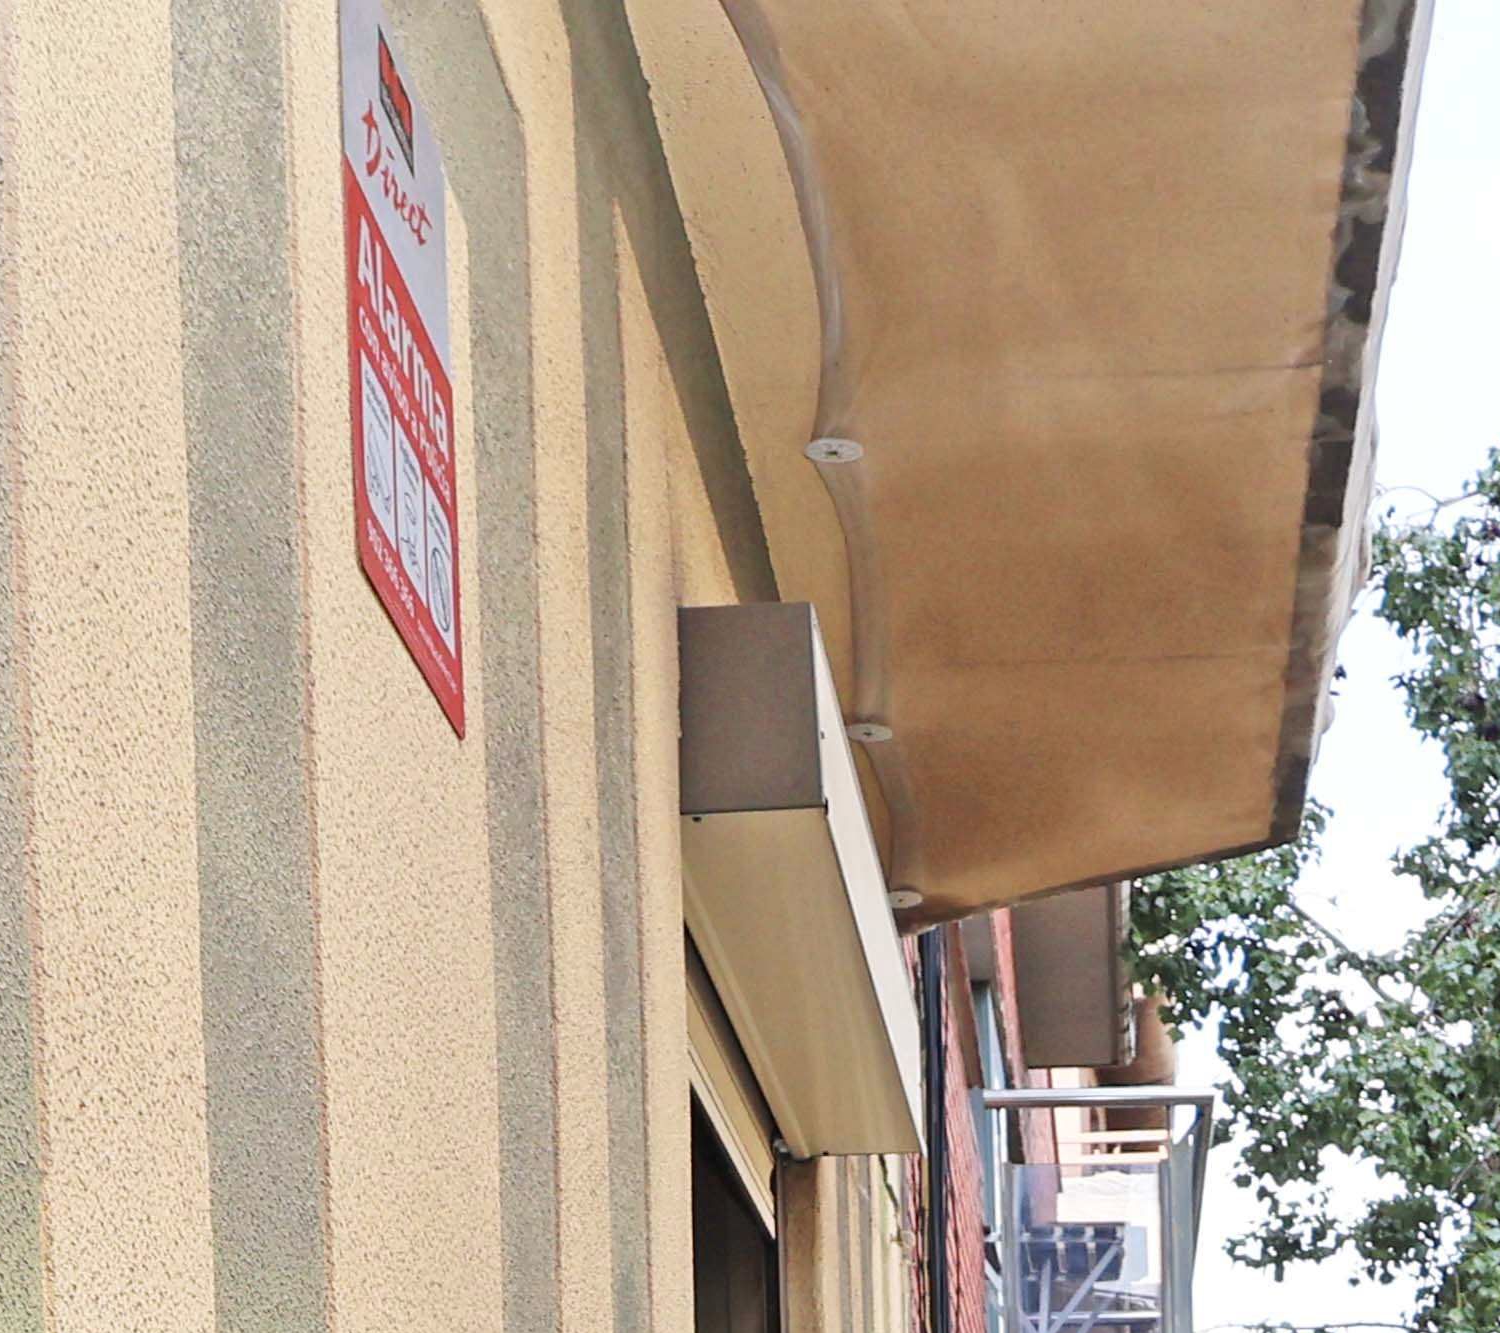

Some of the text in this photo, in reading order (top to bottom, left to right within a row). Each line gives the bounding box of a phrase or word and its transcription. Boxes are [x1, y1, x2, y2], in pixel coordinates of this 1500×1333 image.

[362, 99, 433, 246] Direct
[358, 215, 449, 463] Alarma
[359, 305, 380, 362] con
[381, 350, 410, 422] aviso
[411, 410, 418, 441] a
